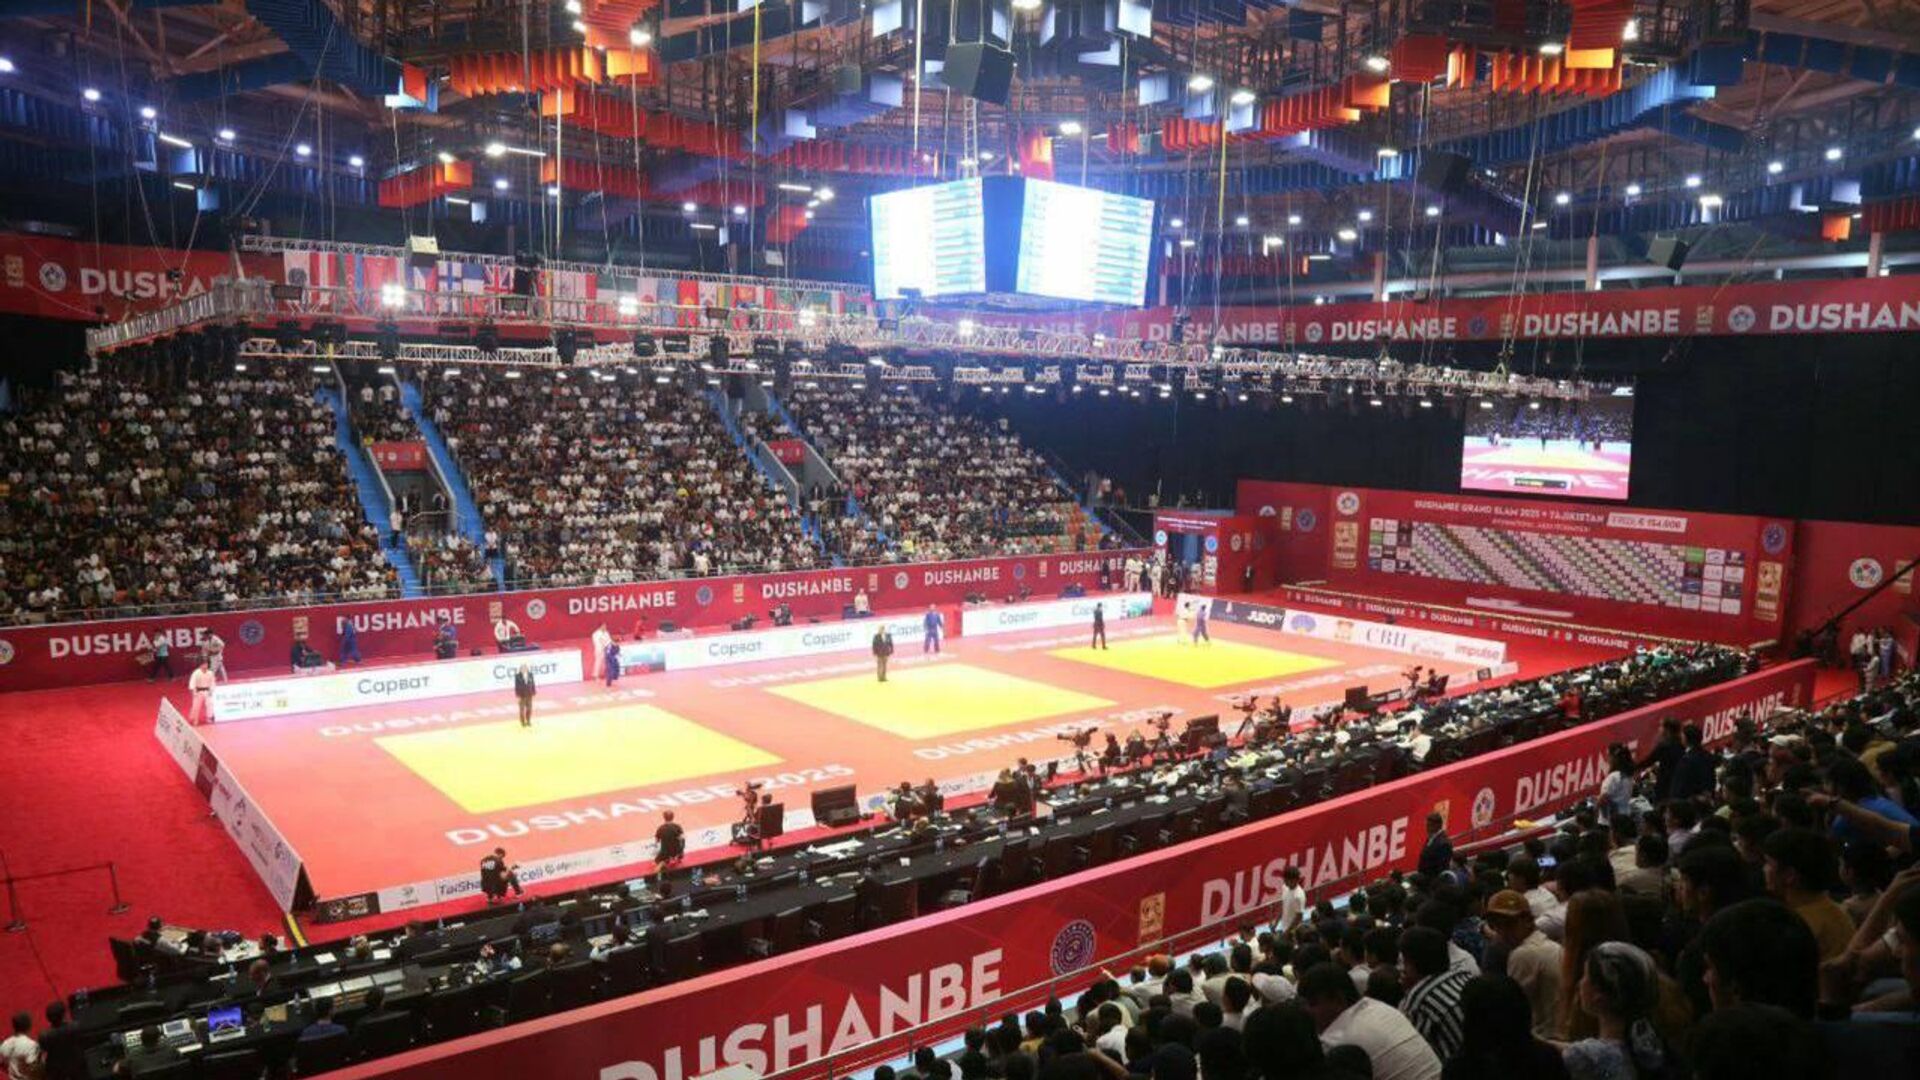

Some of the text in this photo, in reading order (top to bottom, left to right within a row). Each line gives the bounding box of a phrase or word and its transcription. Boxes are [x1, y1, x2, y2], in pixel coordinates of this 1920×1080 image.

[1331, 317, 1457, 342] DUSHANBE
[1523, 308, 1681, 337] DUSHANBE
[924, 567, 1000, 586] DUSHANBE
[1060, 557, 1123, 574] DUSHABE
[762, 578, 852, 599] DUSHANBE
[569, 590, 677, 615] DUSHANBE
[493, 663, 558, 680] Сават
[358, 676, 430, 695] Сарват
[445, 783, 739, 846] DUSHANBE
[1201, 817, 1409, 926] DUSHANBE
